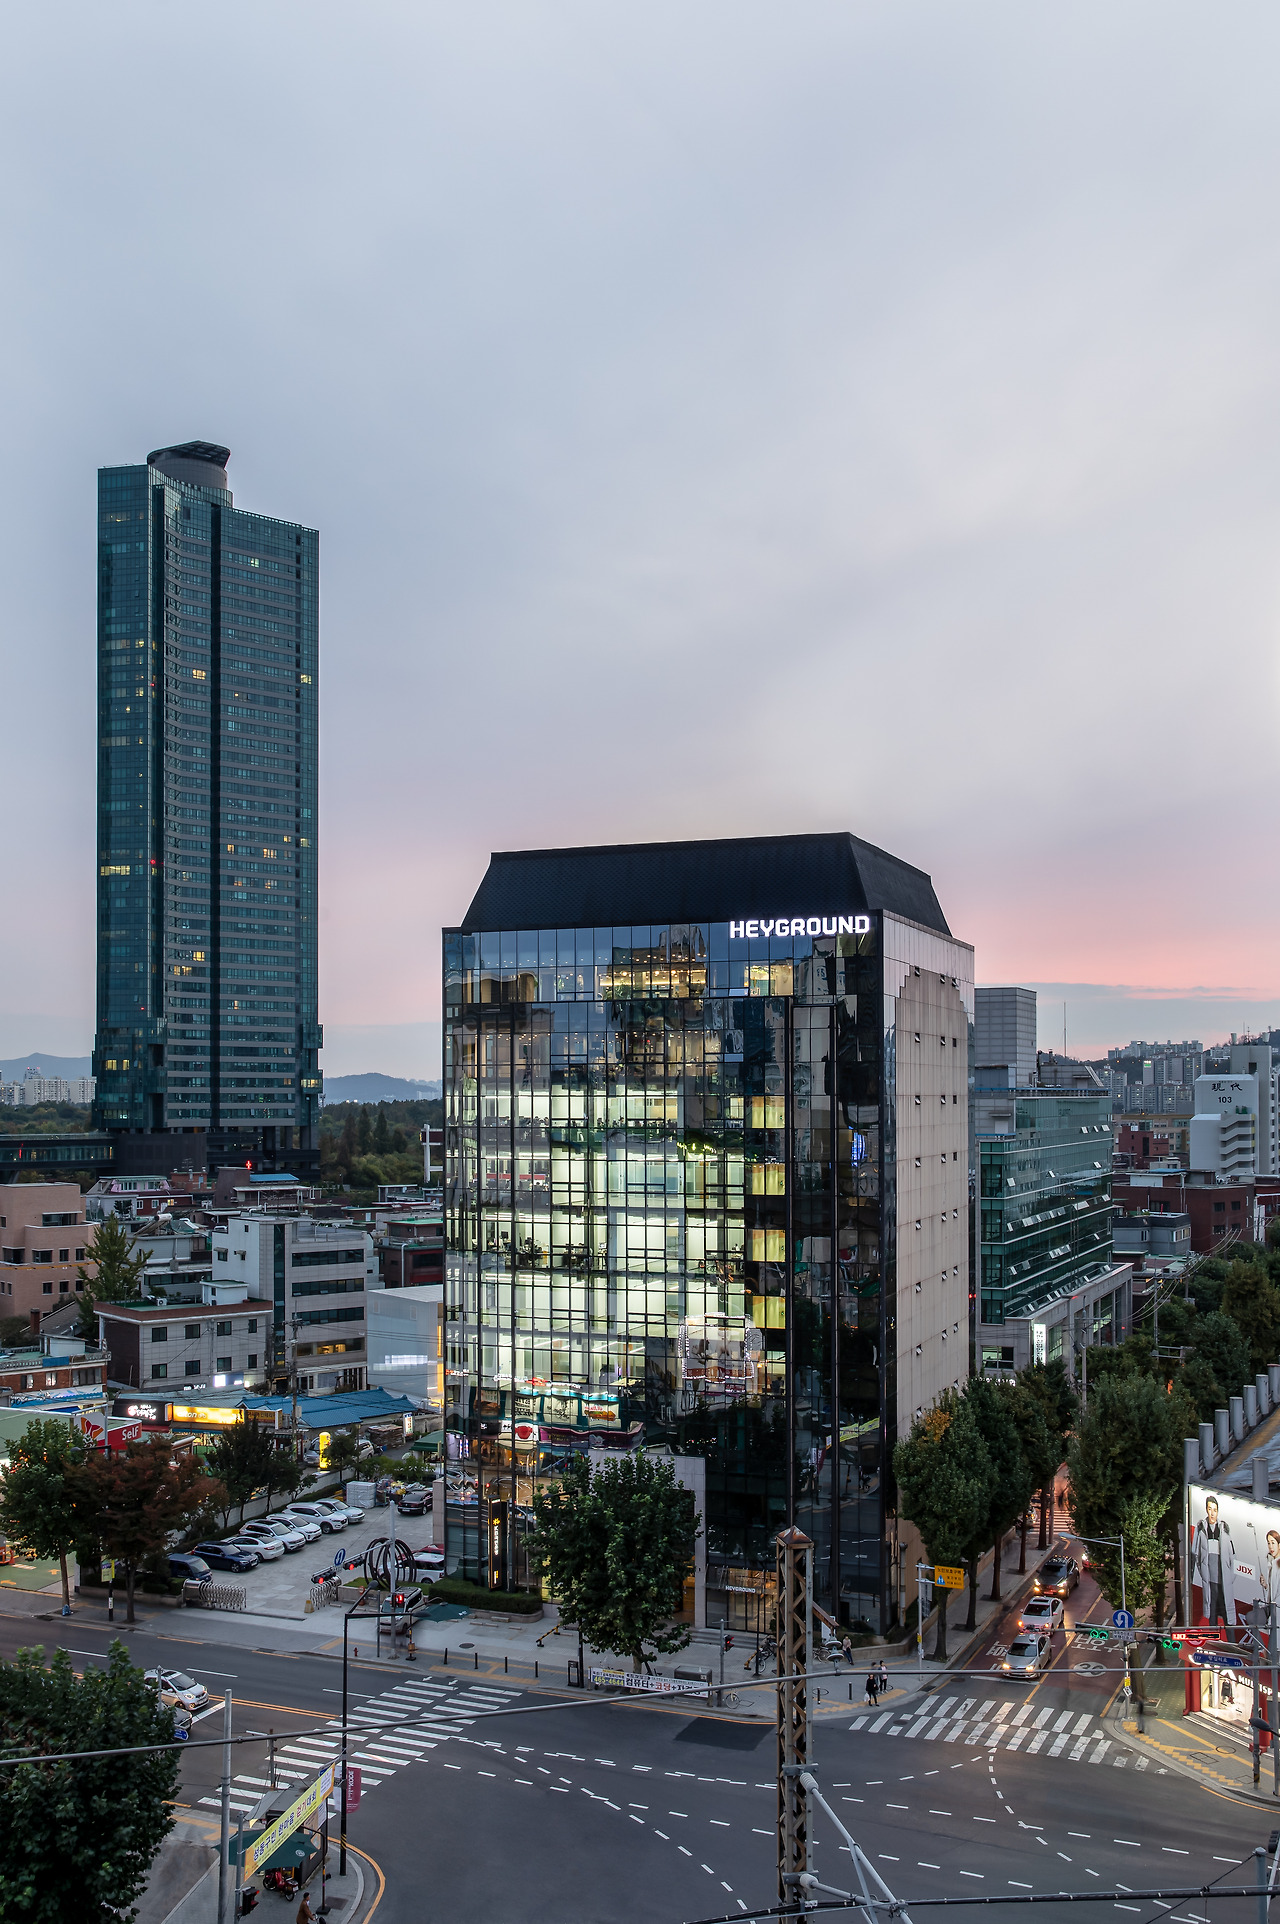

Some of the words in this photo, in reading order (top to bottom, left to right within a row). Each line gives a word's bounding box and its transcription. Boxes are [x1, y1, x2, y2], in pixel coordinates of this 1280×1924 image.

[730, 915, 870, 938] HEYGROUND
[1211, 1083, 1243, 1091] 現代
[122, 1426, 139, 1441] Self
[1236, 1565, 1253, 1576] JDX
[725, 1585, 756, 1594] HEYGROUND
